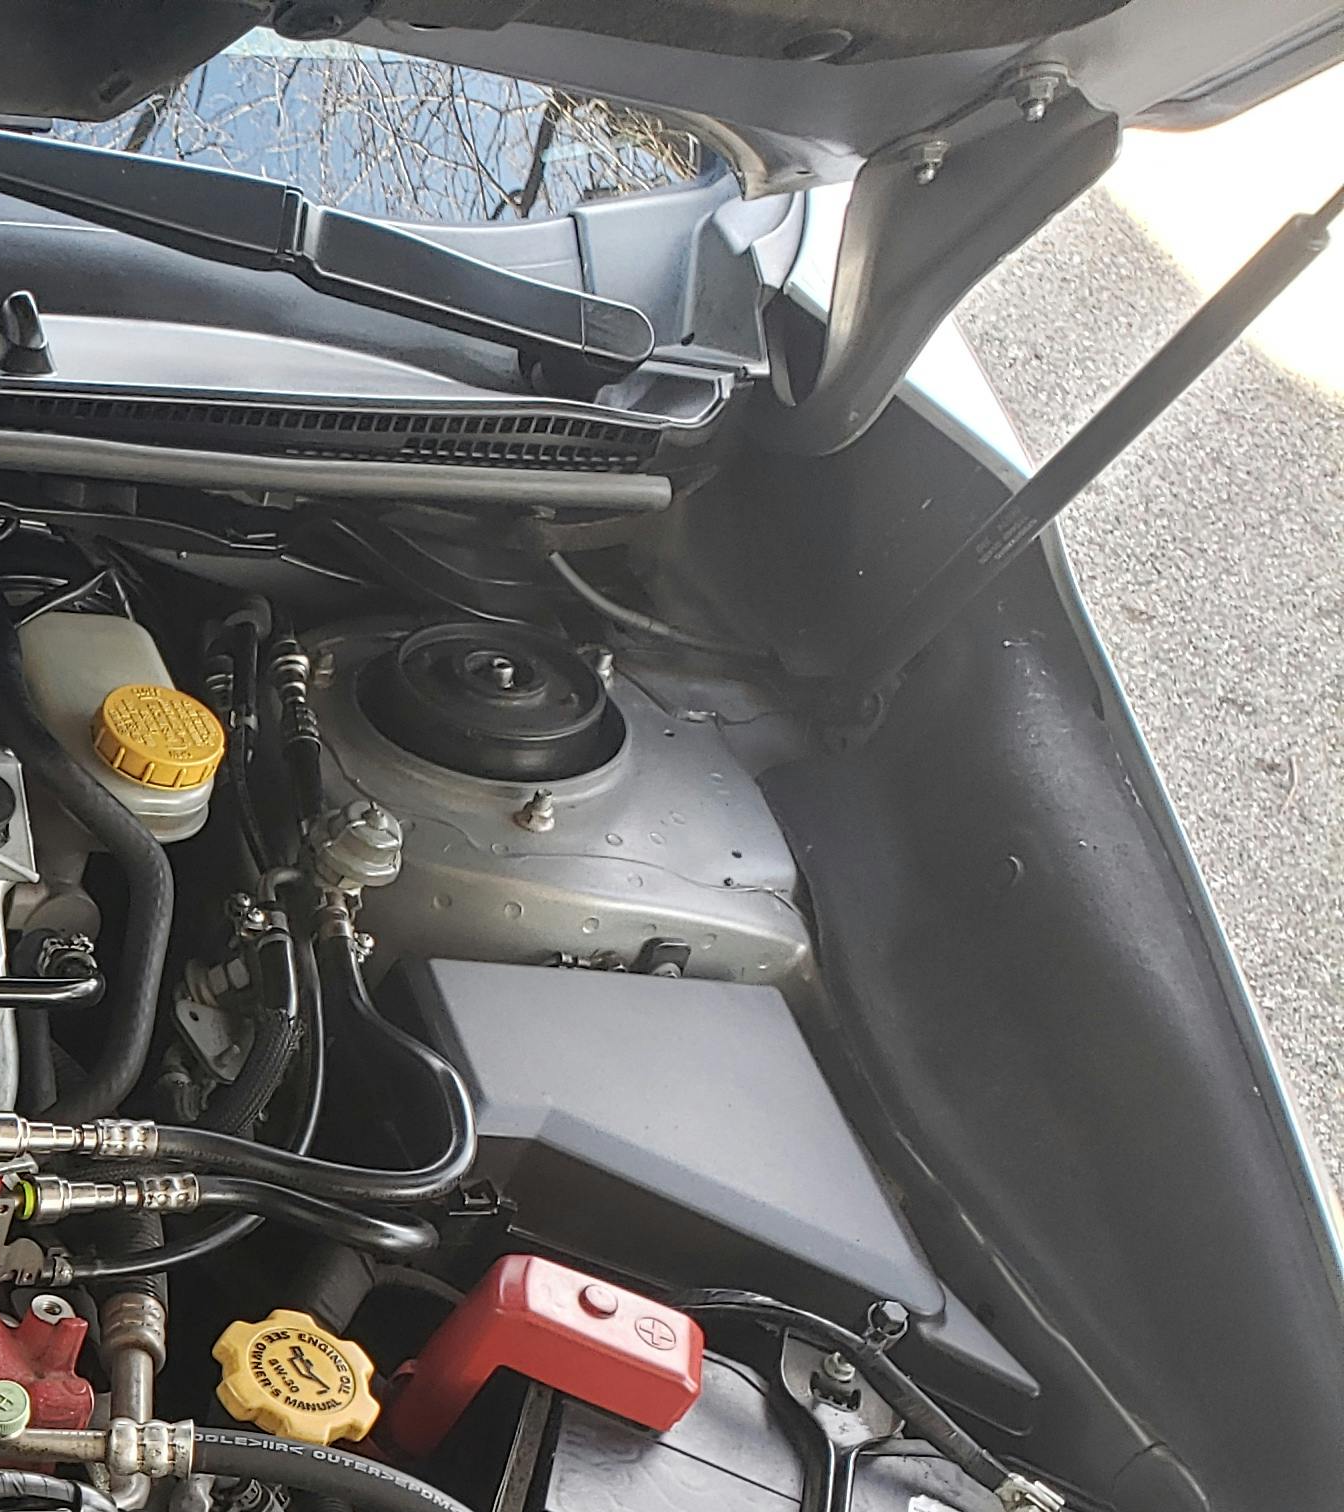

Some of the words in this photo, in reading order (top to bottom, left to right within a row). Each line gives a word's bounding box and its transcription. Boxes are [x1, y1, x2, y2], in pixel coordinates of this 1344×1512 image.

[264, 1330, 291, 1344] SEE
[251, 1343, 282, 1398] OWNER'S
[298, 1332, 347, 1373] ENGINE
[338, 1375, 351, 1395] OIL
[284, 1395, 342, 1412] MANUAL
